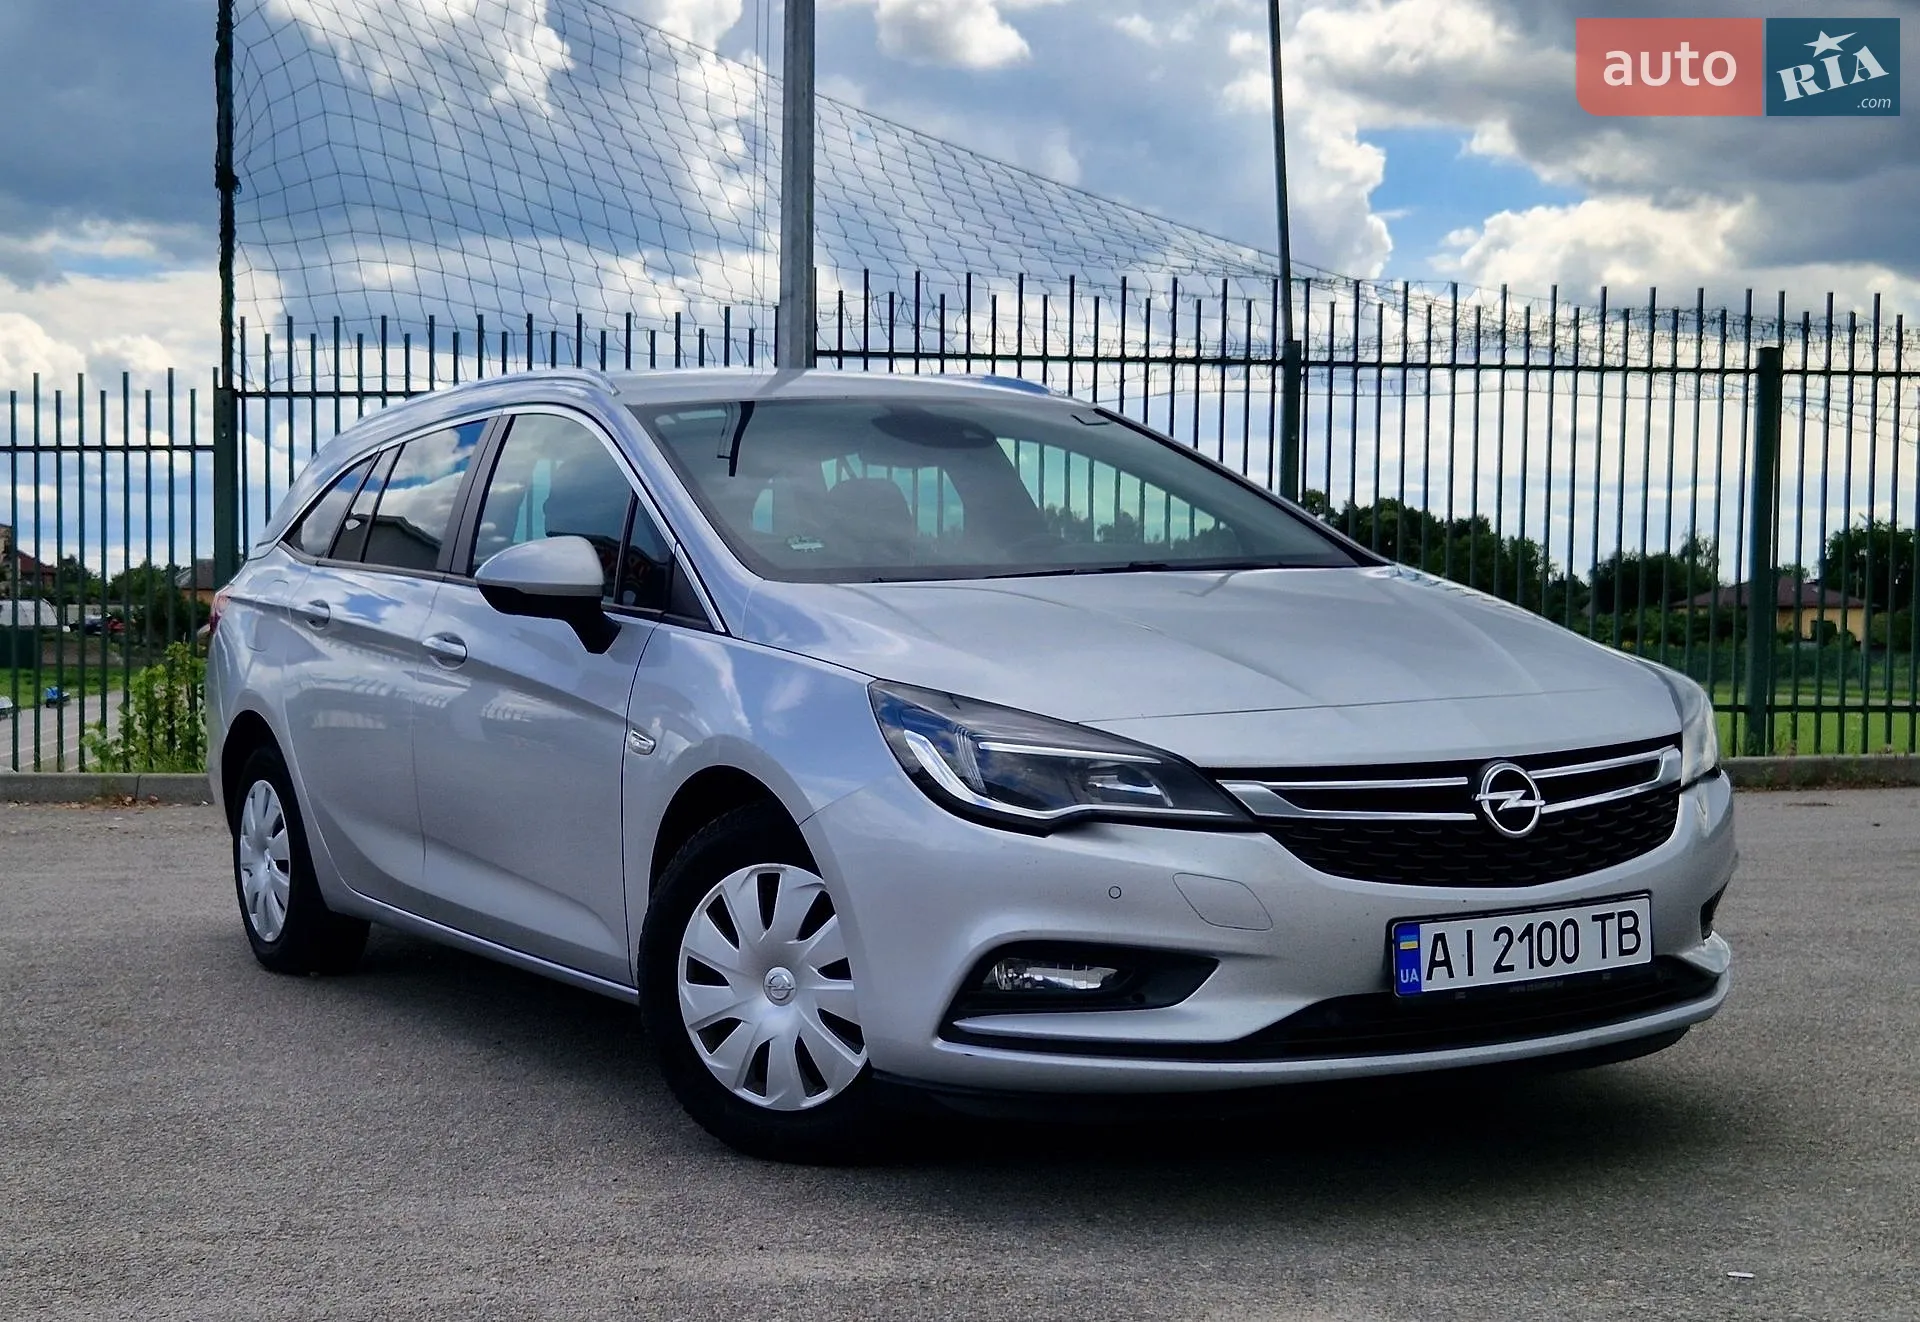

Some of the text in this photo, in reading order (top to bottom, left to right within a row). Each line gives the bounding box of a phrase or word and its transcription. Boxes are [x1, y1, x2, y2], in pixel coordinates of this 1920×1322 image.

[1426, 909, 1642, 981] AI 2100 TB
[1400, 968, 1419, 984] UA
